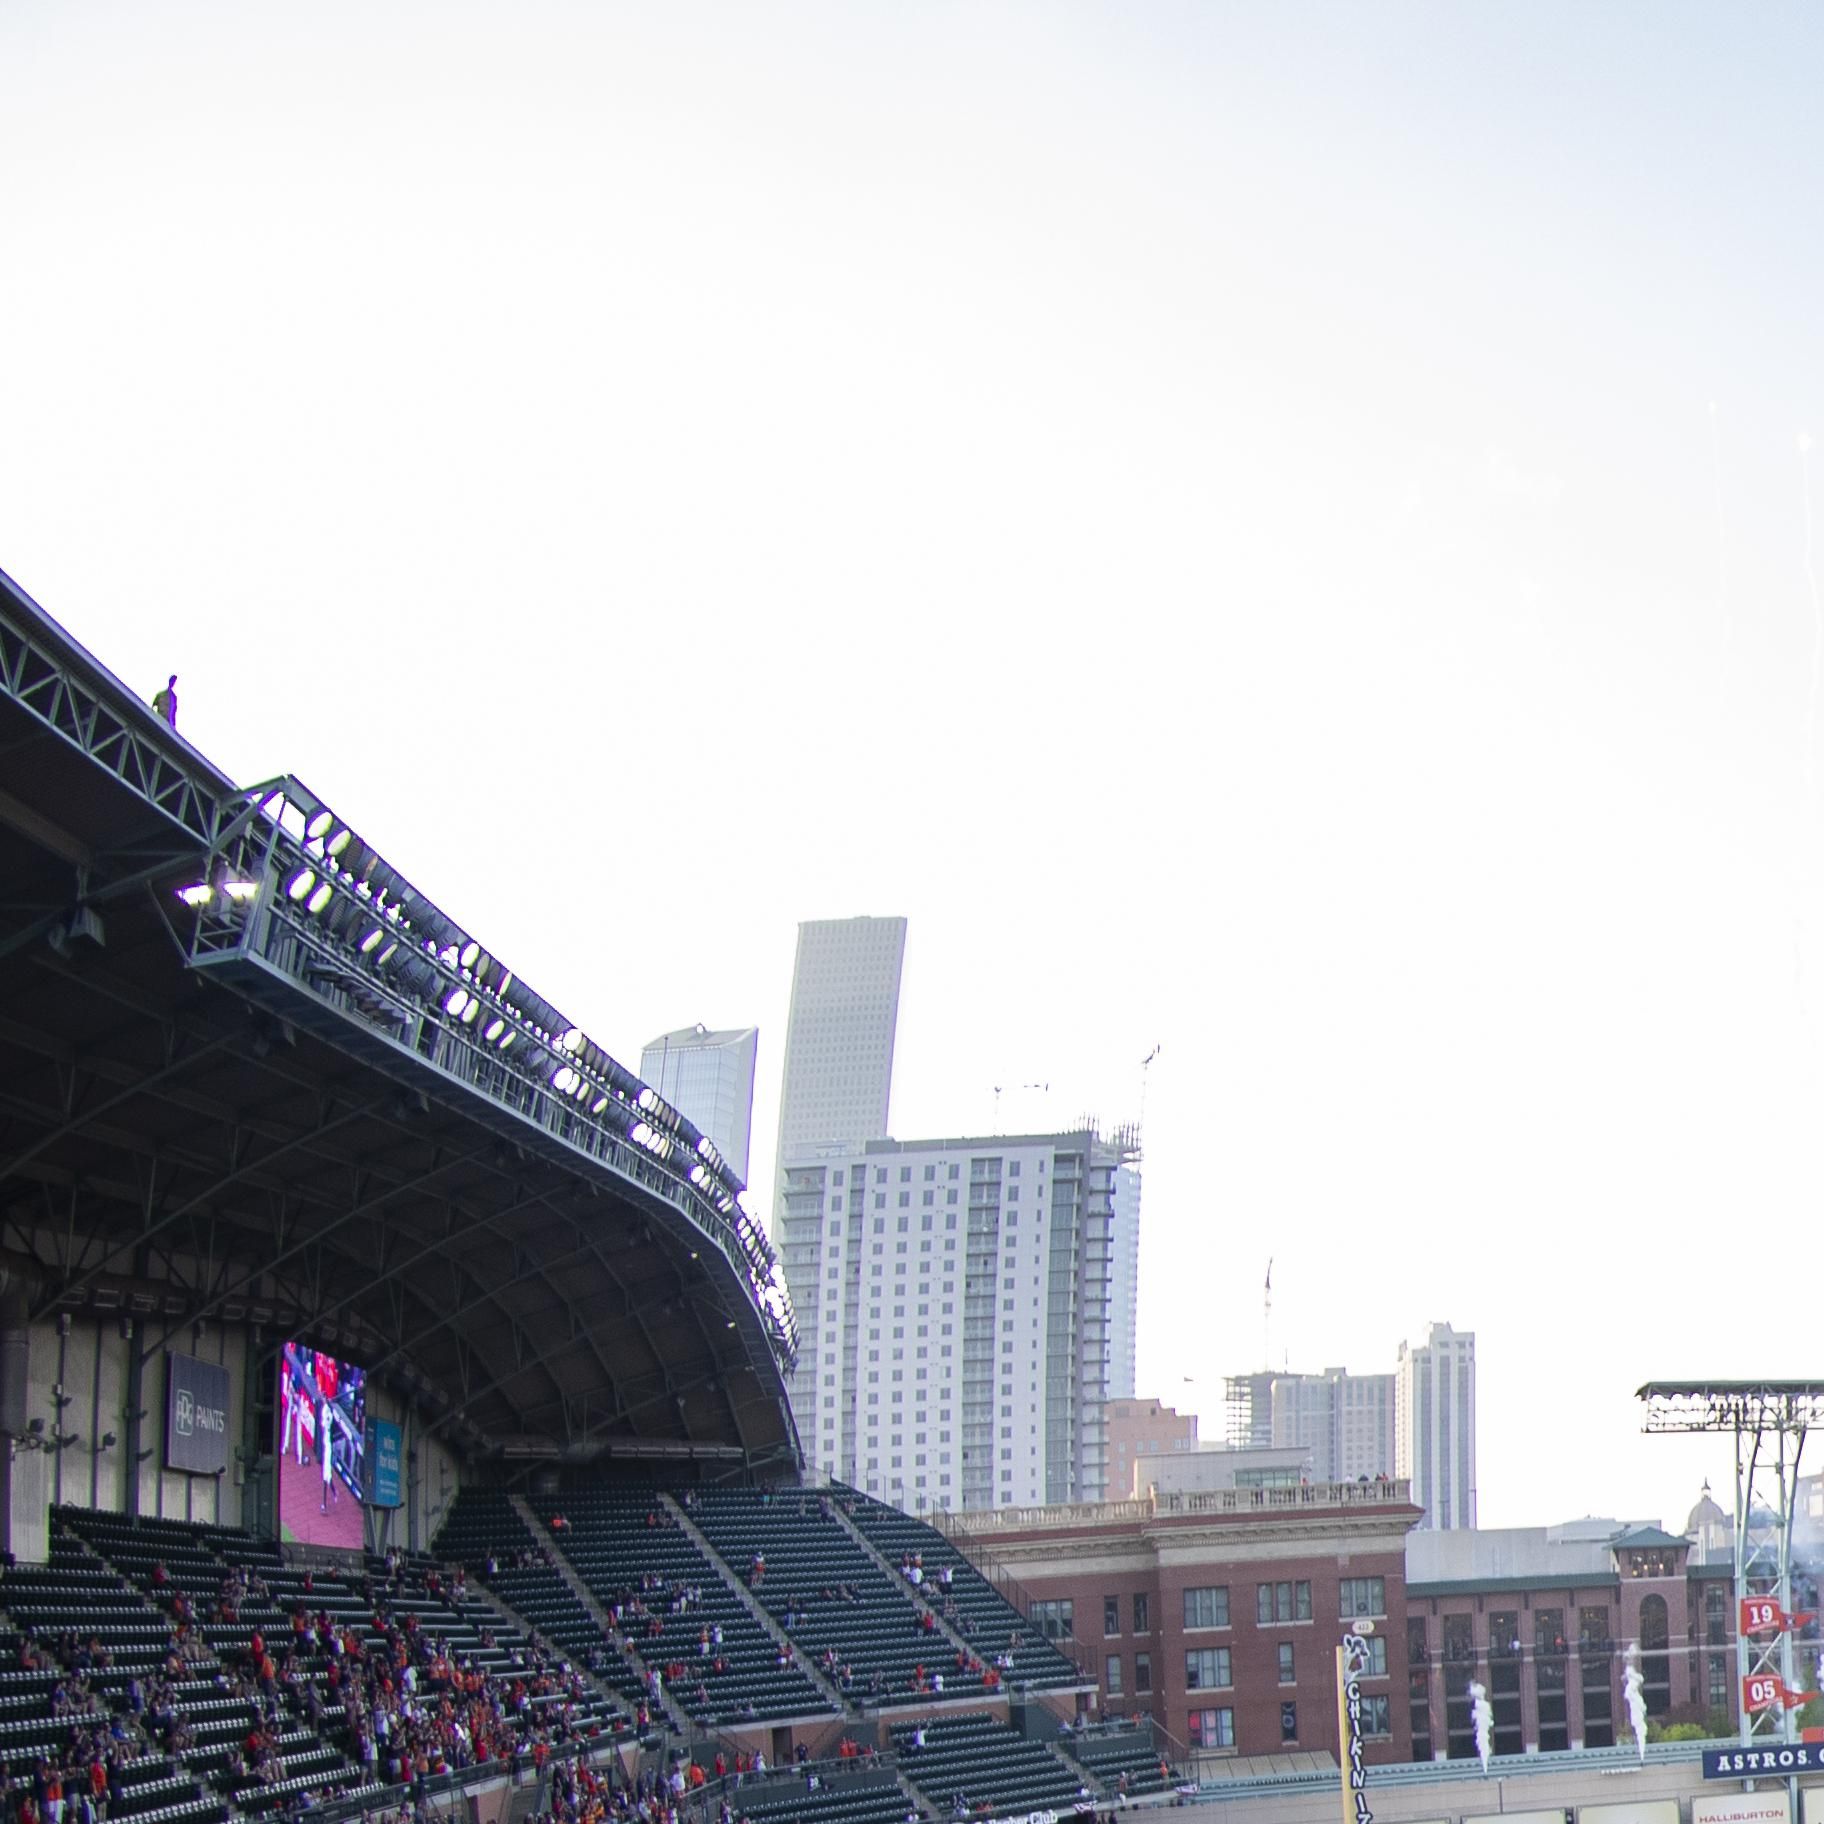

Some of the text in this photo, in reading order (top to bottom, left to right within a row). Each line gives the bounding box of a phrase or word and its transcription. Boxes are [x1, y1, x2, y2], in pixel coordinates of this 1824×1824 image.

[196, 1404, 225, 1433] PAINTS
[1750, 1604, 1773, 1624] 19
[1750, 1680, 1776, 1702] 05
[1347, 1682, 1367, 1789] CHIKIN
[1717, 1749, 1808, 1772] ASTROS
[1699, 1809, 1784, 1823] HALLIBURTON
